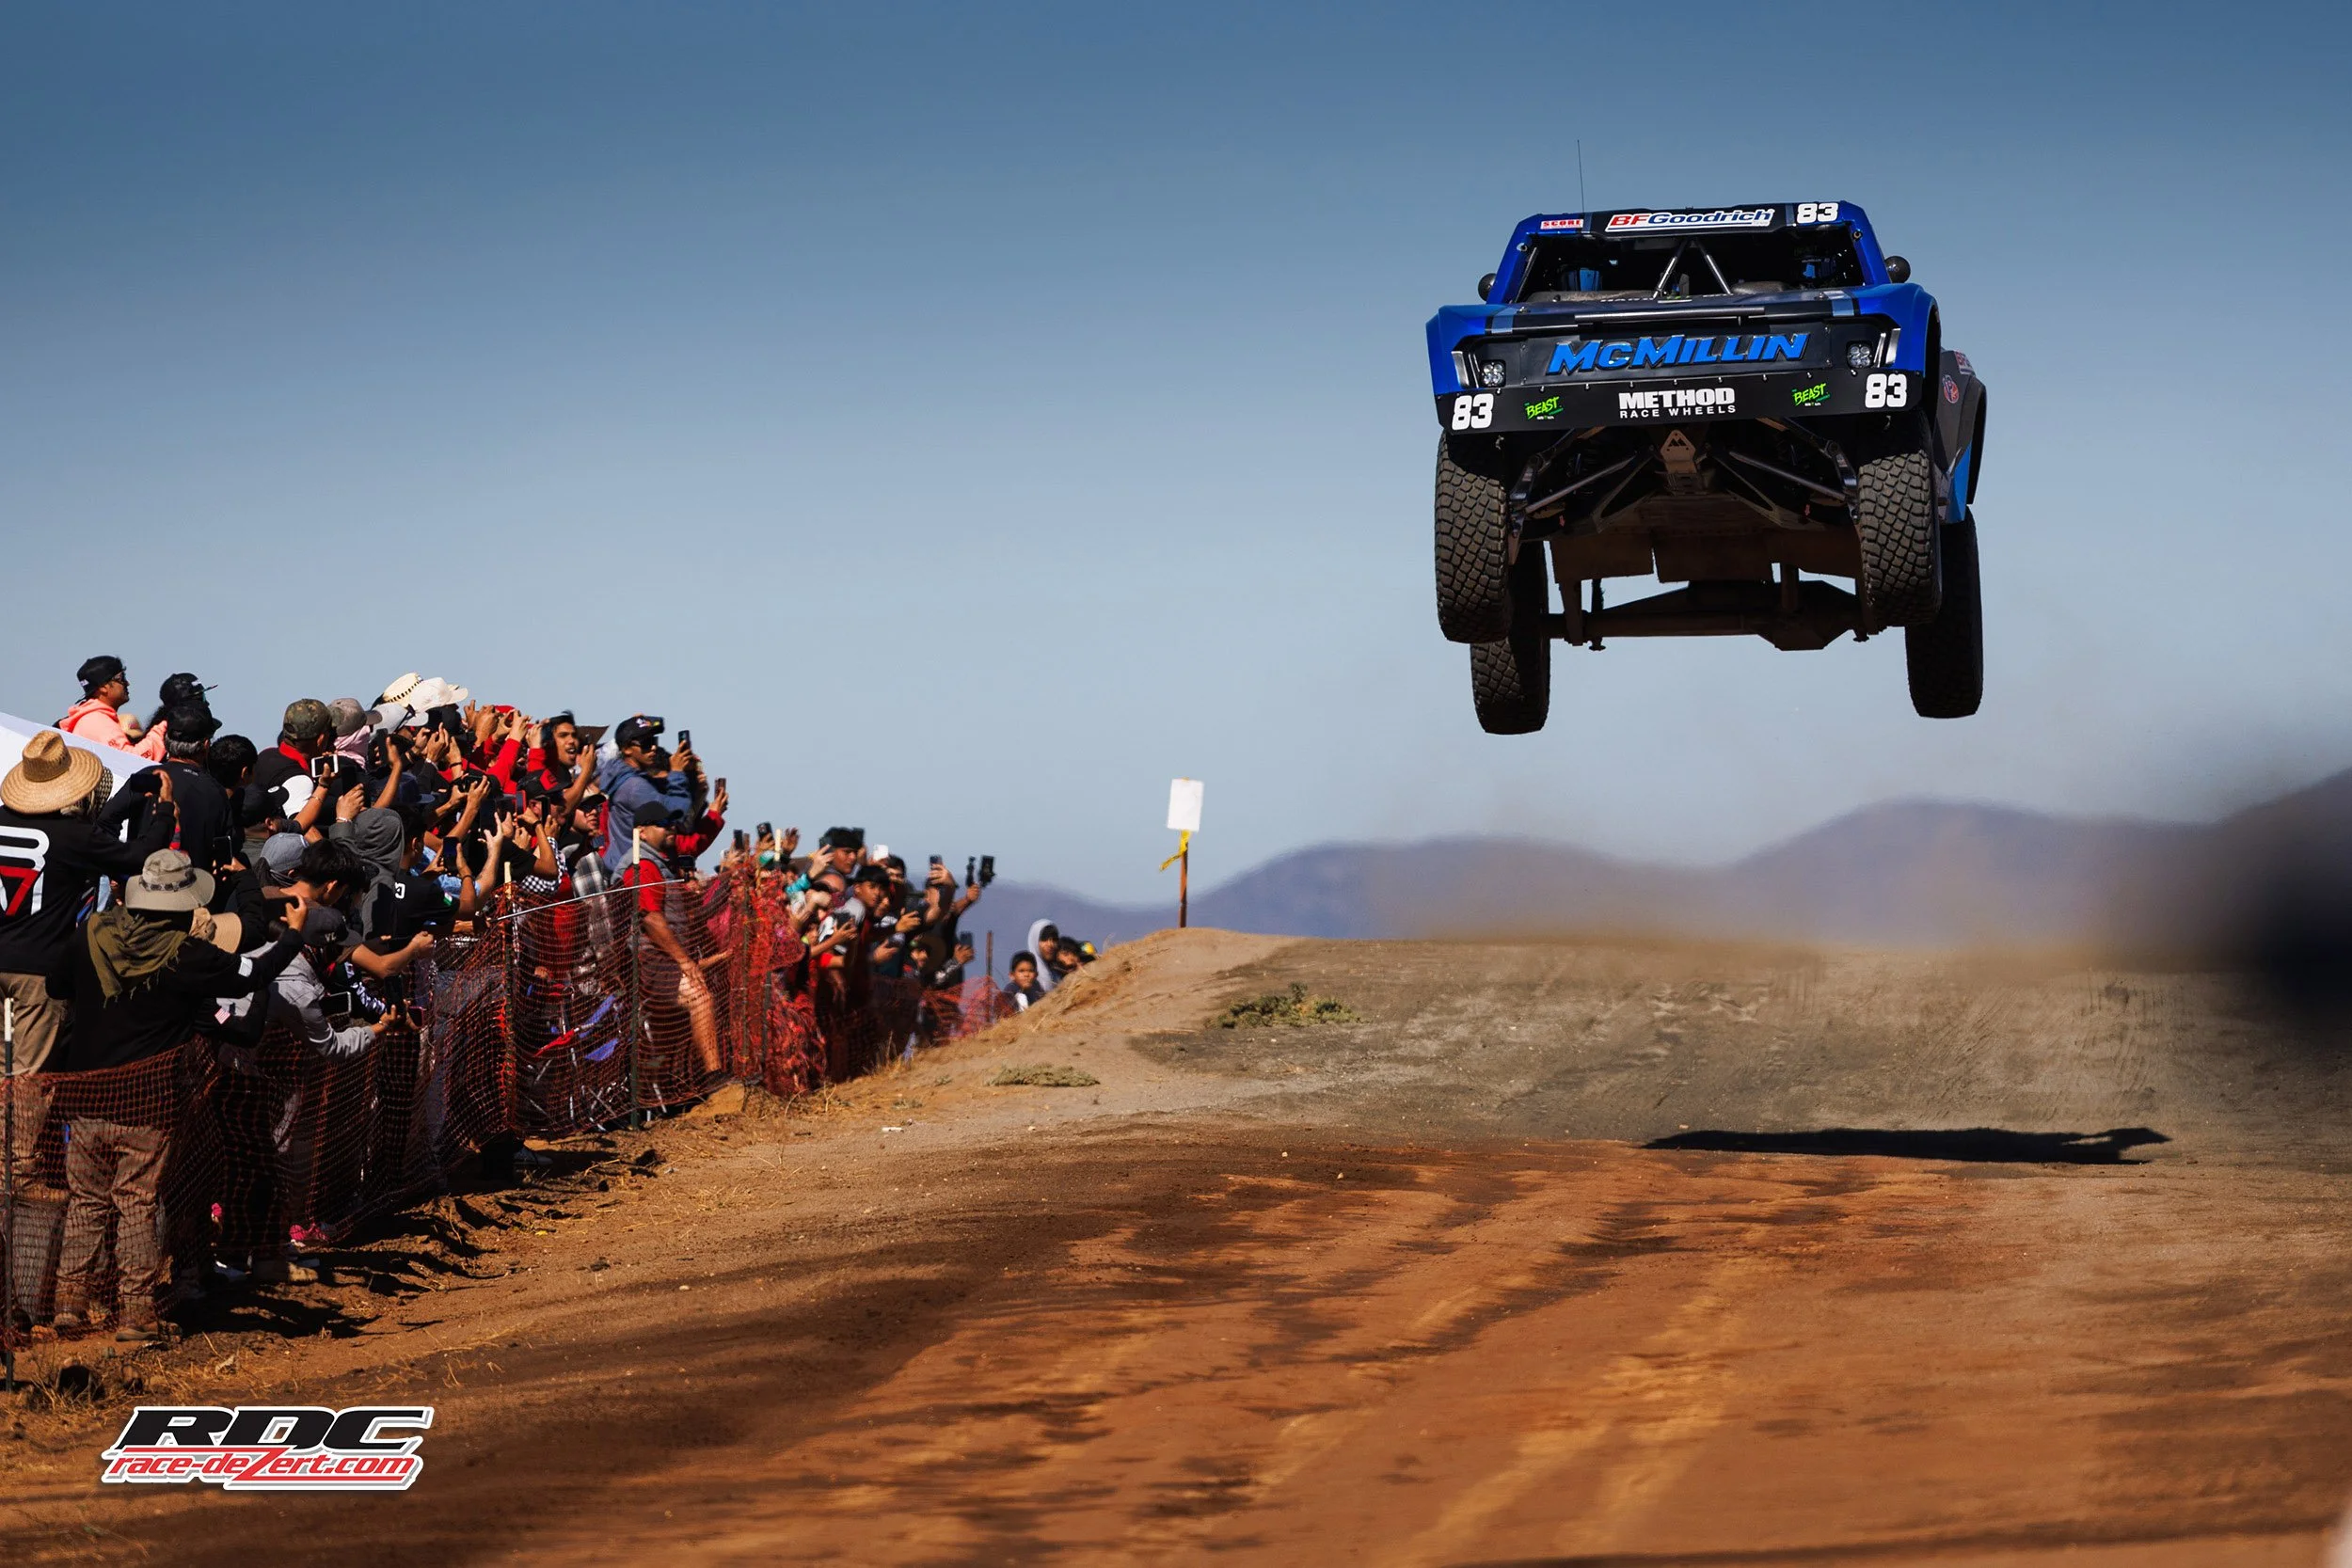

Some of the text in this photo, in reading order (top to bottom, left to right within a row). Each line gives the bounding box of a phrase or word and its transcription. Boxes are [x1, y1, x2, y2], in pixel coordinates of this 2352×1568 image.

[1543, 219, 1581, 228] SCORE
[1609, 209, 1772, 227] BFGoodrich
[1797, 202, 1838, 224] 83
[1618, 388, 1735, 409] METHOD
[1793, 383, 1826, 405] BEAST
[1865, 373, 1907, 408] 83
[1452, 393, 1494, 430] 83
[1526, 396, 1559, 419] BEAST
[1620, 404, 1736, 419] RACE WHEELS
